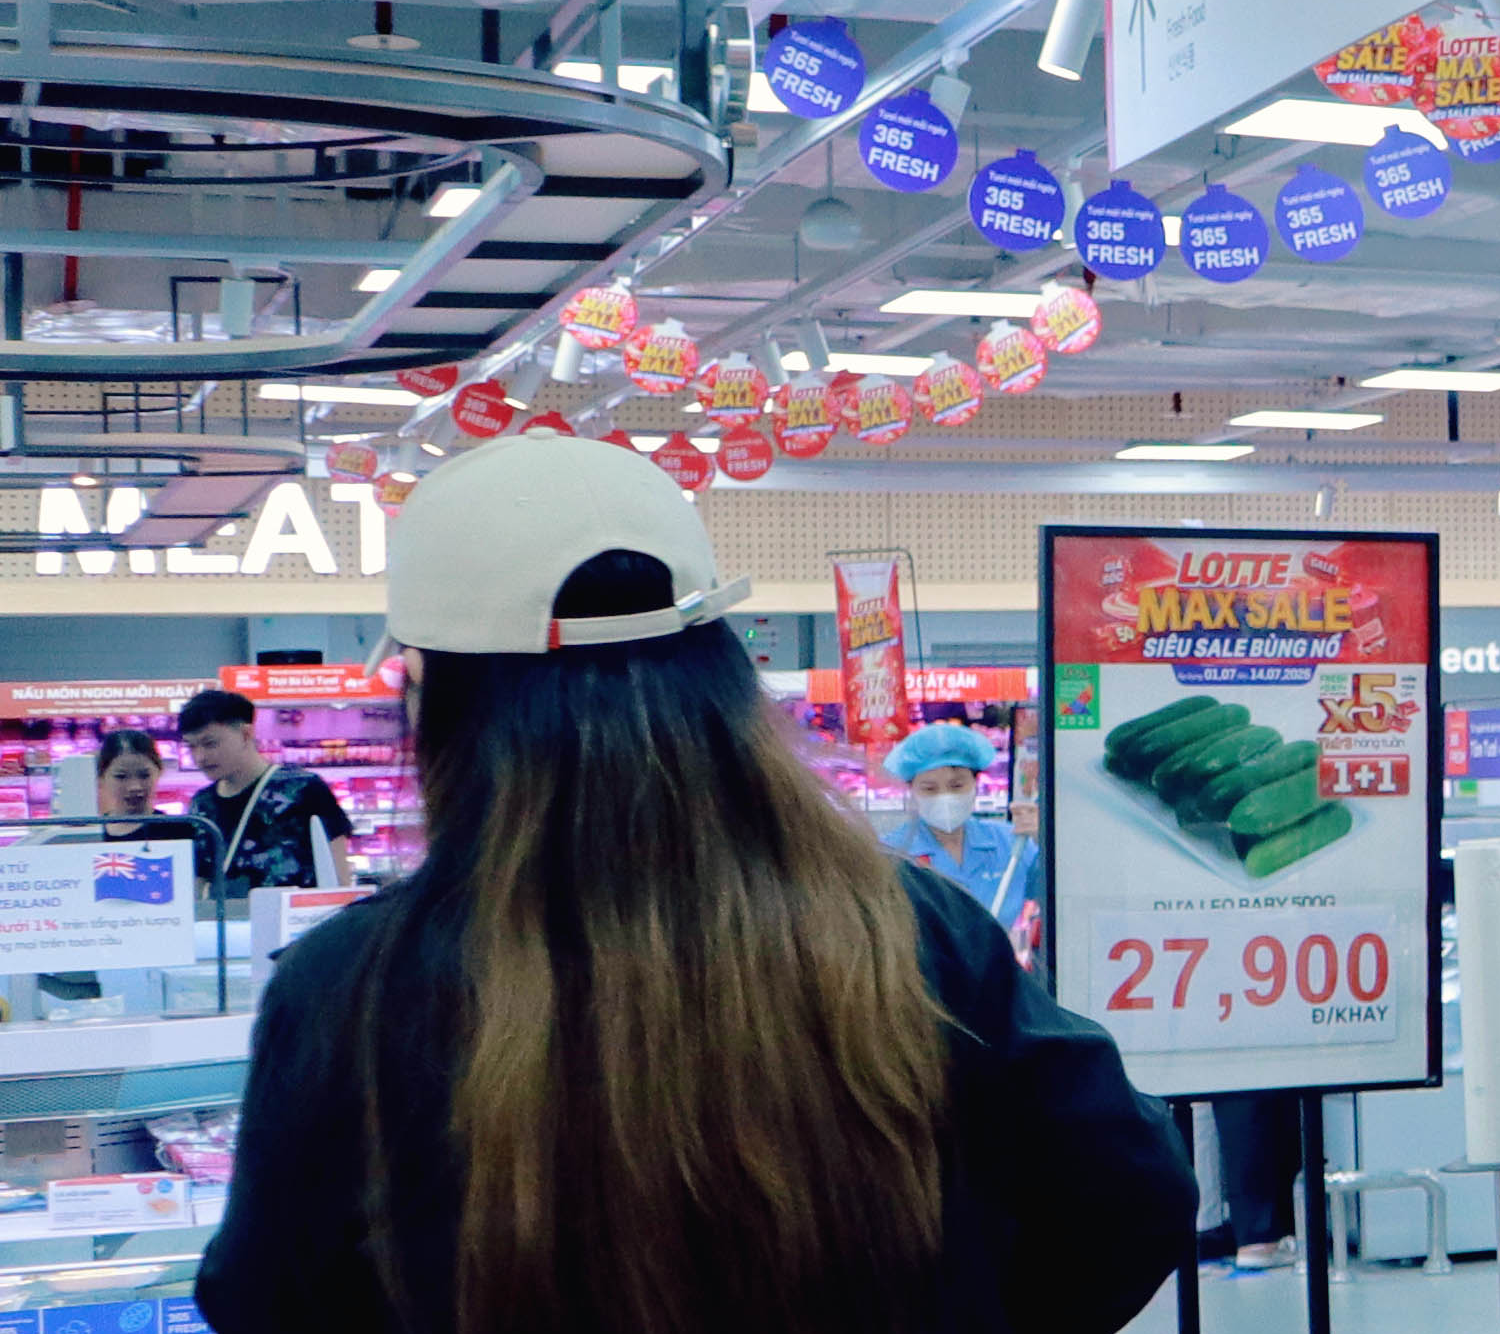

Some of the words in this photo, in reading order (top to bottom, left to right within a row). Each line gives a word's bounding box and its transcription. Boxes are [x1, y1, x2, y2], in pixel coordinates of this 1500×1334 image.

[873, 124, 914, 150] 365
[867, 147, 940, 182] FRESH
[984, 185, 1024, 210] 365
[981, 209, 1051, 240] FRESH
[1178, 552, 1291, 587] LOTTE
[1138, 589, 1240, 633] MAX
[1247, 589, 1353, 631] SALE
[1333, 761, 1396, 792] 1+1
[34, 879, 80, 891] GLORY
[1106, 933, 1390, 1021] 27,900
[1311, 1005, 1389, 1025] Đ/KHAY
